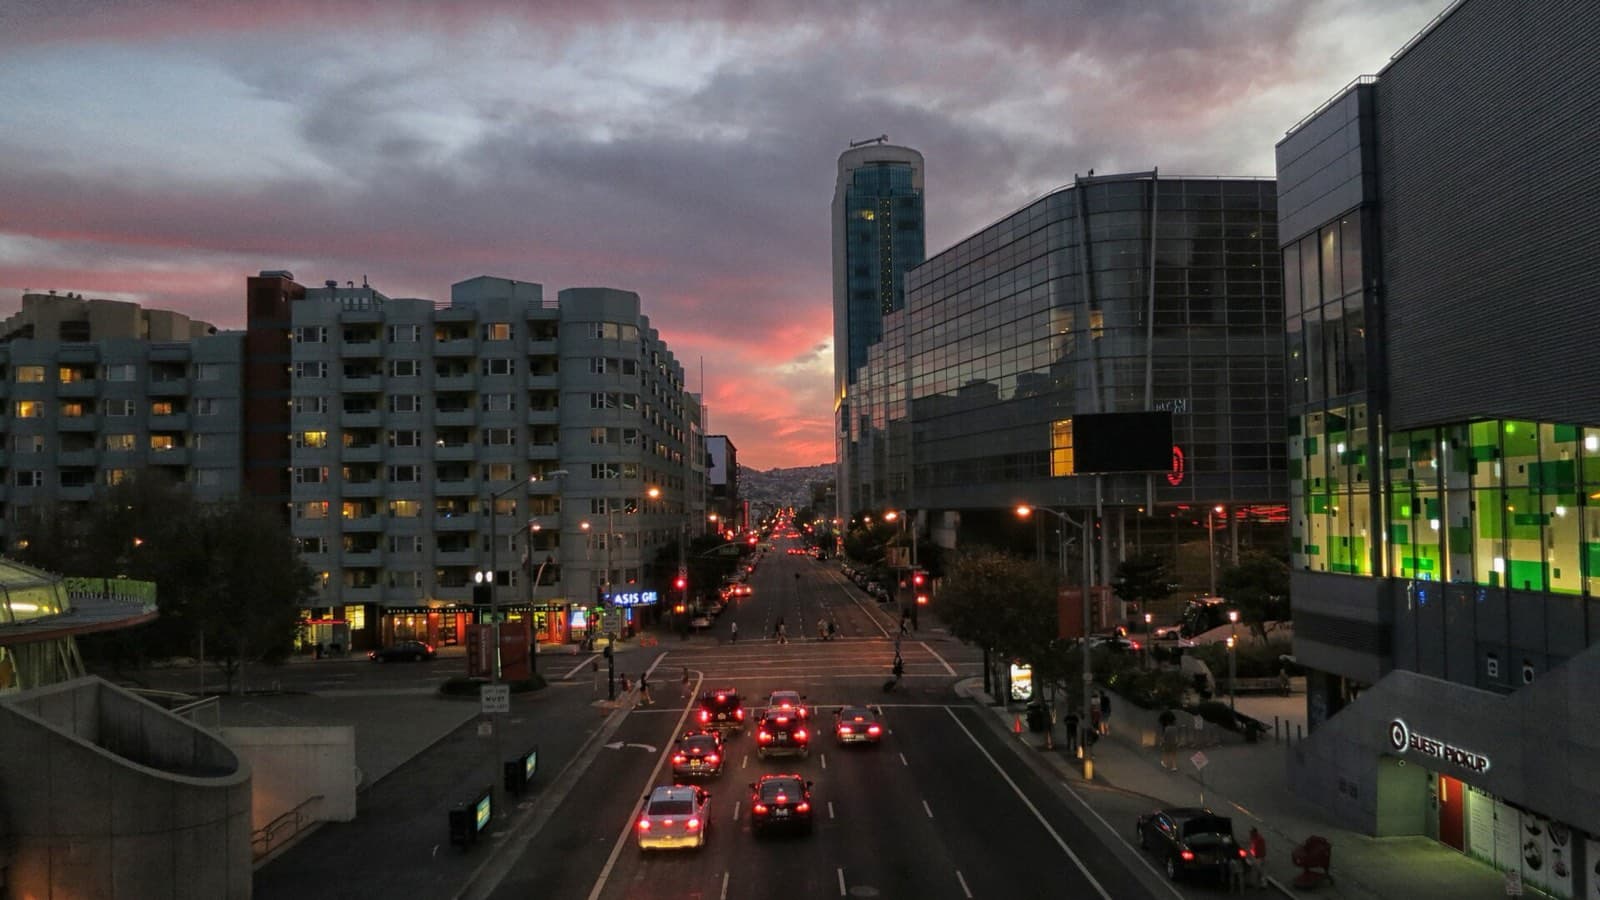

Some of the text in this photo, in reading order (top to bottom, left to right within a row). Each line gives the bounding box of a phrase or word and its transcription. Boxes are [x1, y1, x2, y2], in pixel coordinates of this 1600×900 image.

[605, 592, 640, 605] ASIS
[1409, 732, 1490, 773] GUEST PICKUP
